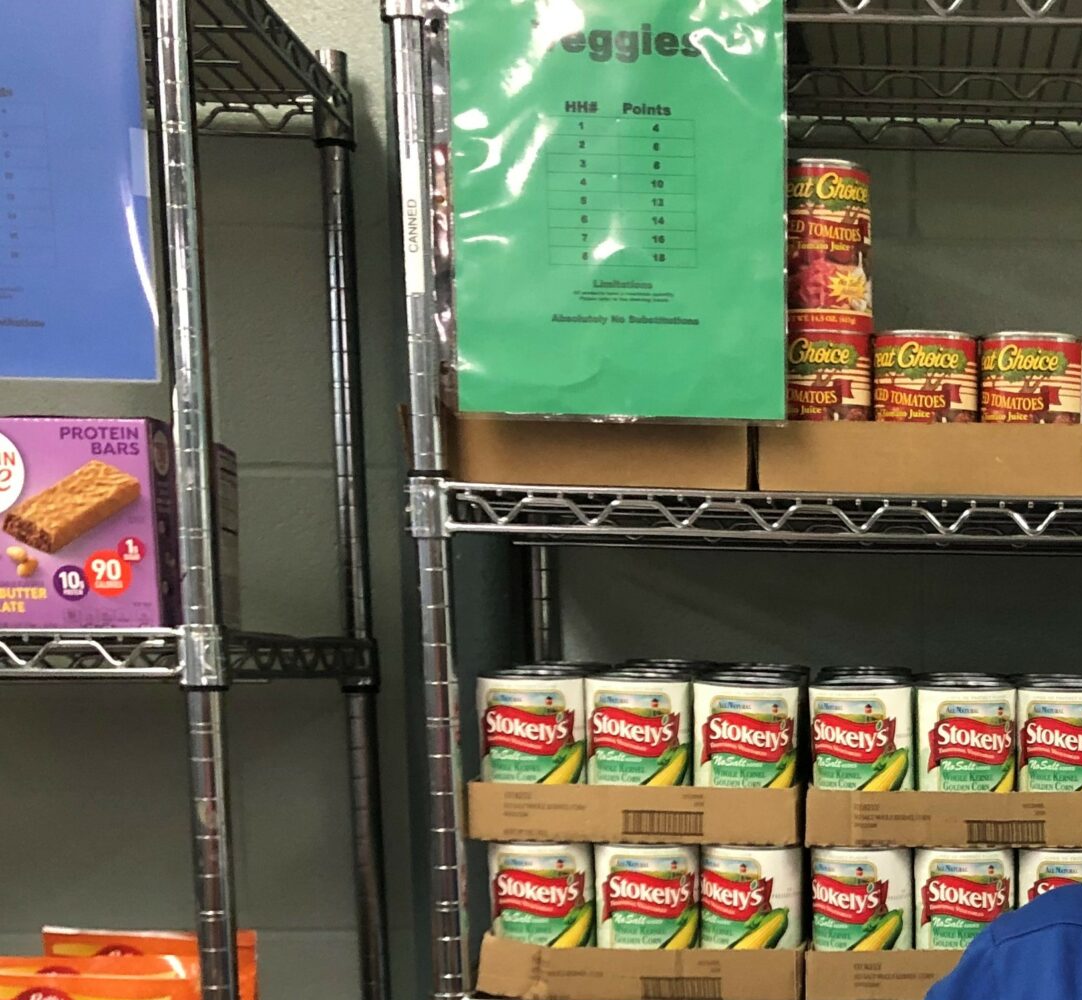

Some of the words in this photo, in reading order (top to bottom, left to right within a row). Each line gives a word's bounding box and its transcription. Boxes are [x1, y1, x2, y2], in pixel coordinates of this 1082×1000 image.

[548, 23, 701, 63] eggies
[622, 103, 671, 116] Points
[651, 180, 664, 189] 10
[816, 172, 868, 202] Choice
[651, 198, 664, 207] 12
[407, 199, 418, 253] CANNED
[652, 217, 665, 225] 14
[652, 235, 665, 243] 16
[808, 221, 861, 241] TOMATOES
[552, 314, 607, 325] Absolutely
[611, 315, 625, 323] No
[629, 315, 699, 325] Substitutions
[789, 338, 850, 364] Choice
[897, 341, 959, 369] Choice
[998, 344, 1058, 371] Choice
[891, 392, 946, 408] TOMATOES
[991, 394, 1044, 410] TOMATOES
[59, 427, 139, 441] PROTEIN
[91, 442, 140, 455] BARS
[91, 559, 122, 581] 90
